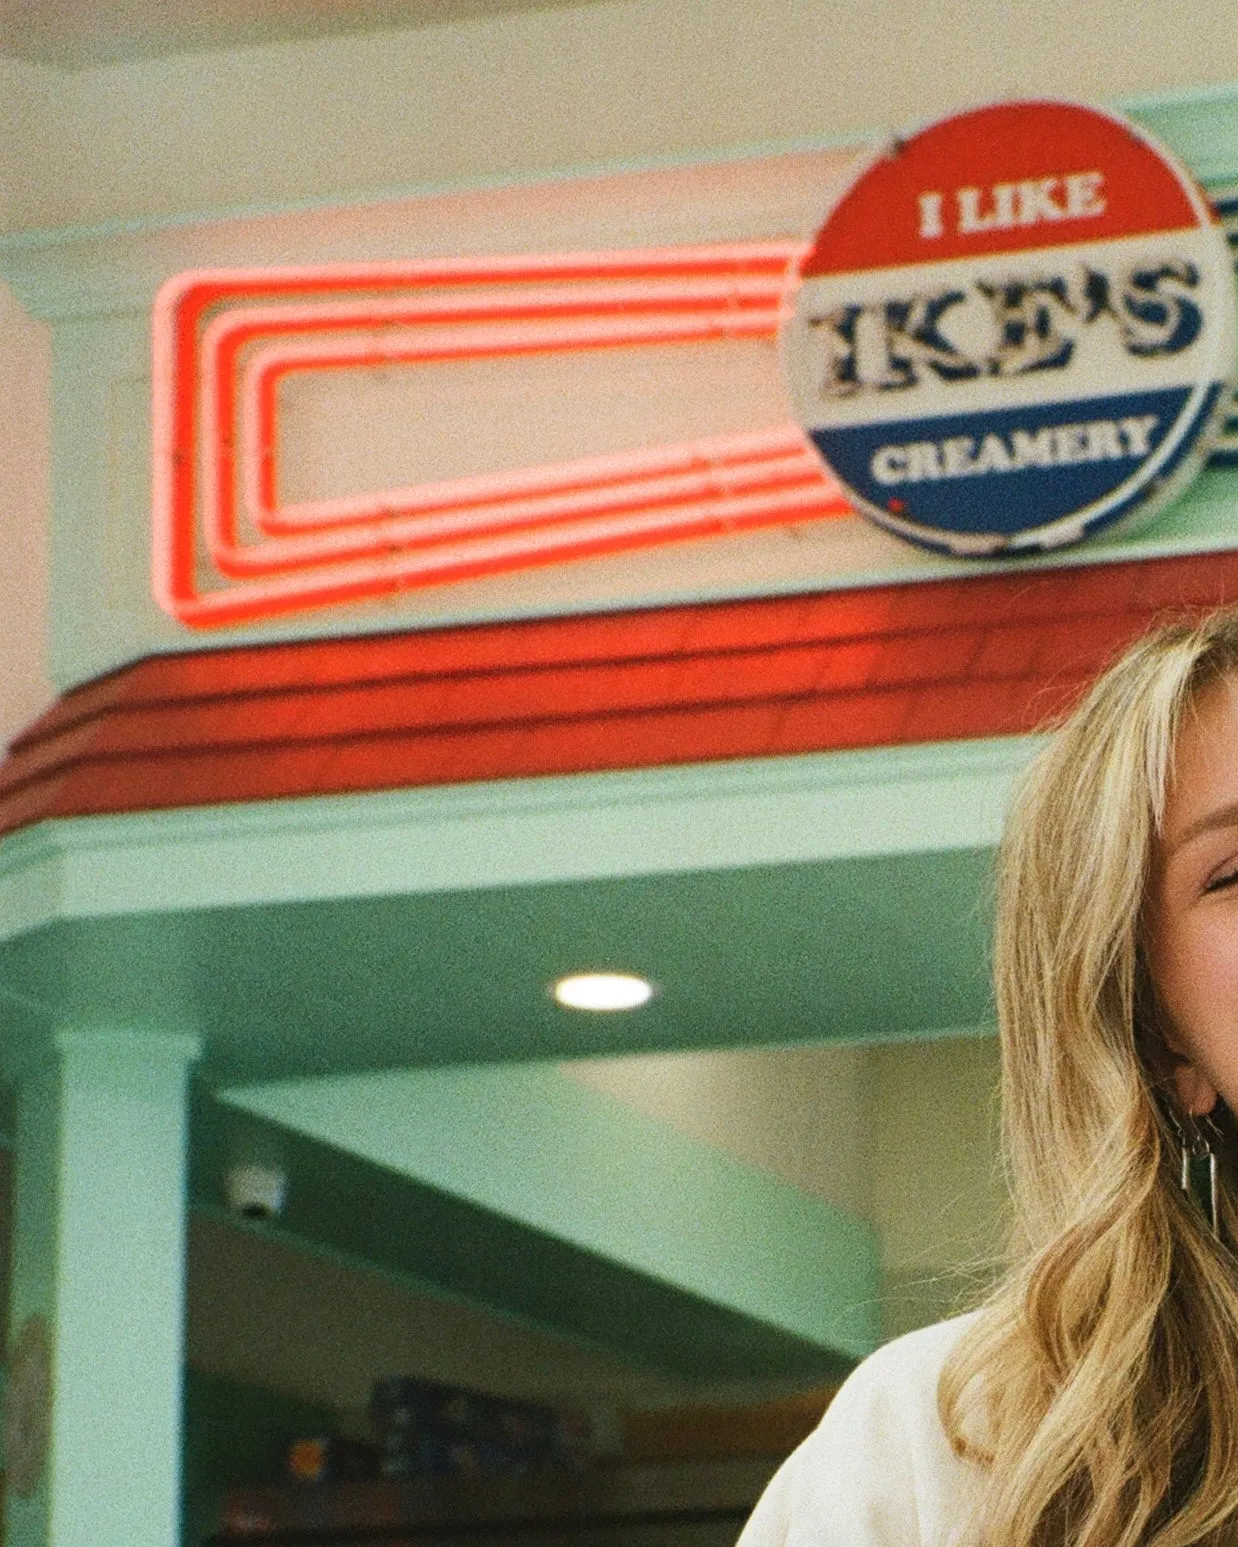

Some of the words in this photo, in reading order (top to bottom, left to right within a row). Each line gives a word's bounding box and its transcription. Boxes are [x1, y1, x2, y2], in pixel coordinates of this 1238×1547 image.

[916, 191, 943, 240] I
[957, 171, 1108, 235] LIKE
[808, 261, 1203, 395] IKE'S
[870, 416, 1159, 485] CREAMERY
